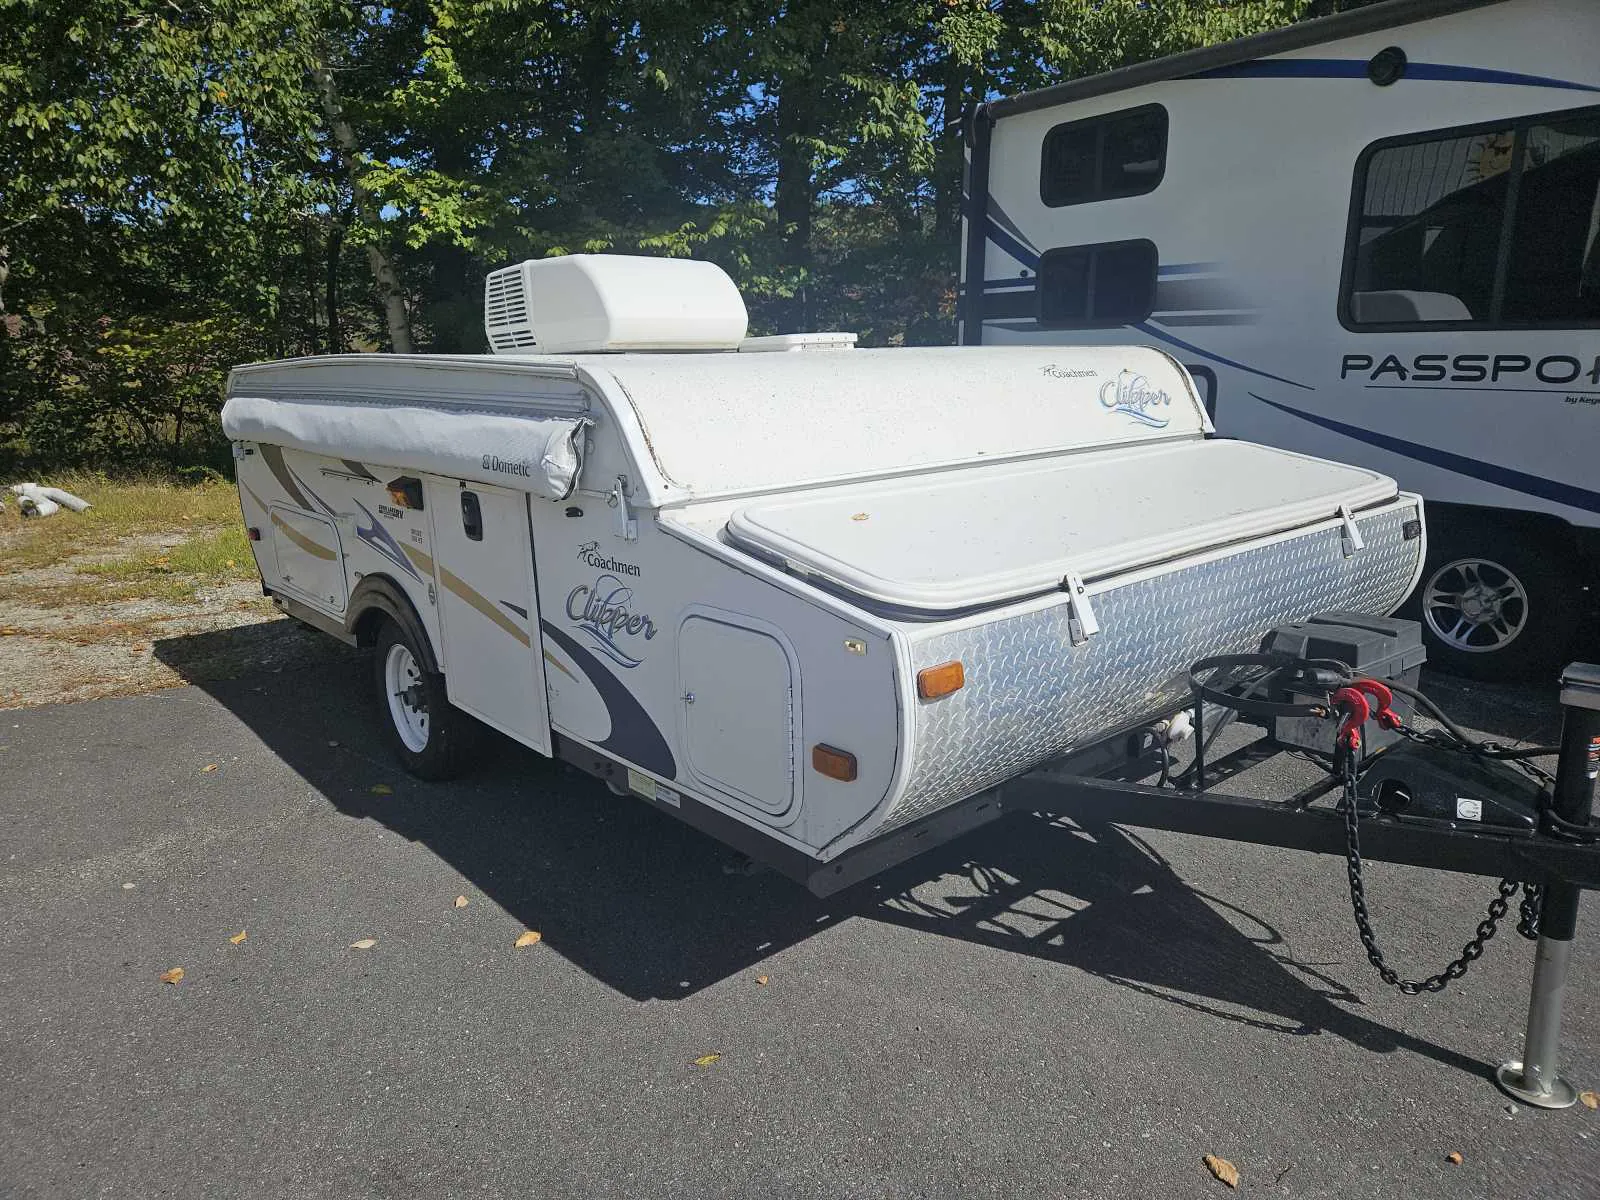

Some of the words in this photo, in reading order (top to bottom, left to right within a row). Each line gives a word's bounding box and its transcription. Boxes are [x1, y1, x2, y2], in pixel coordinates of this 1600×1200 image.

[1052, 367, 1098, 379] Coachmen
[1099, 374, 1172, 412] Clipper
[1565, 396, 1578, 405] by
[492, 455, 531, 477] Dometic
[587, 553, 641, 577] Coachmen
[566, 582, 658, 641] Clipper
